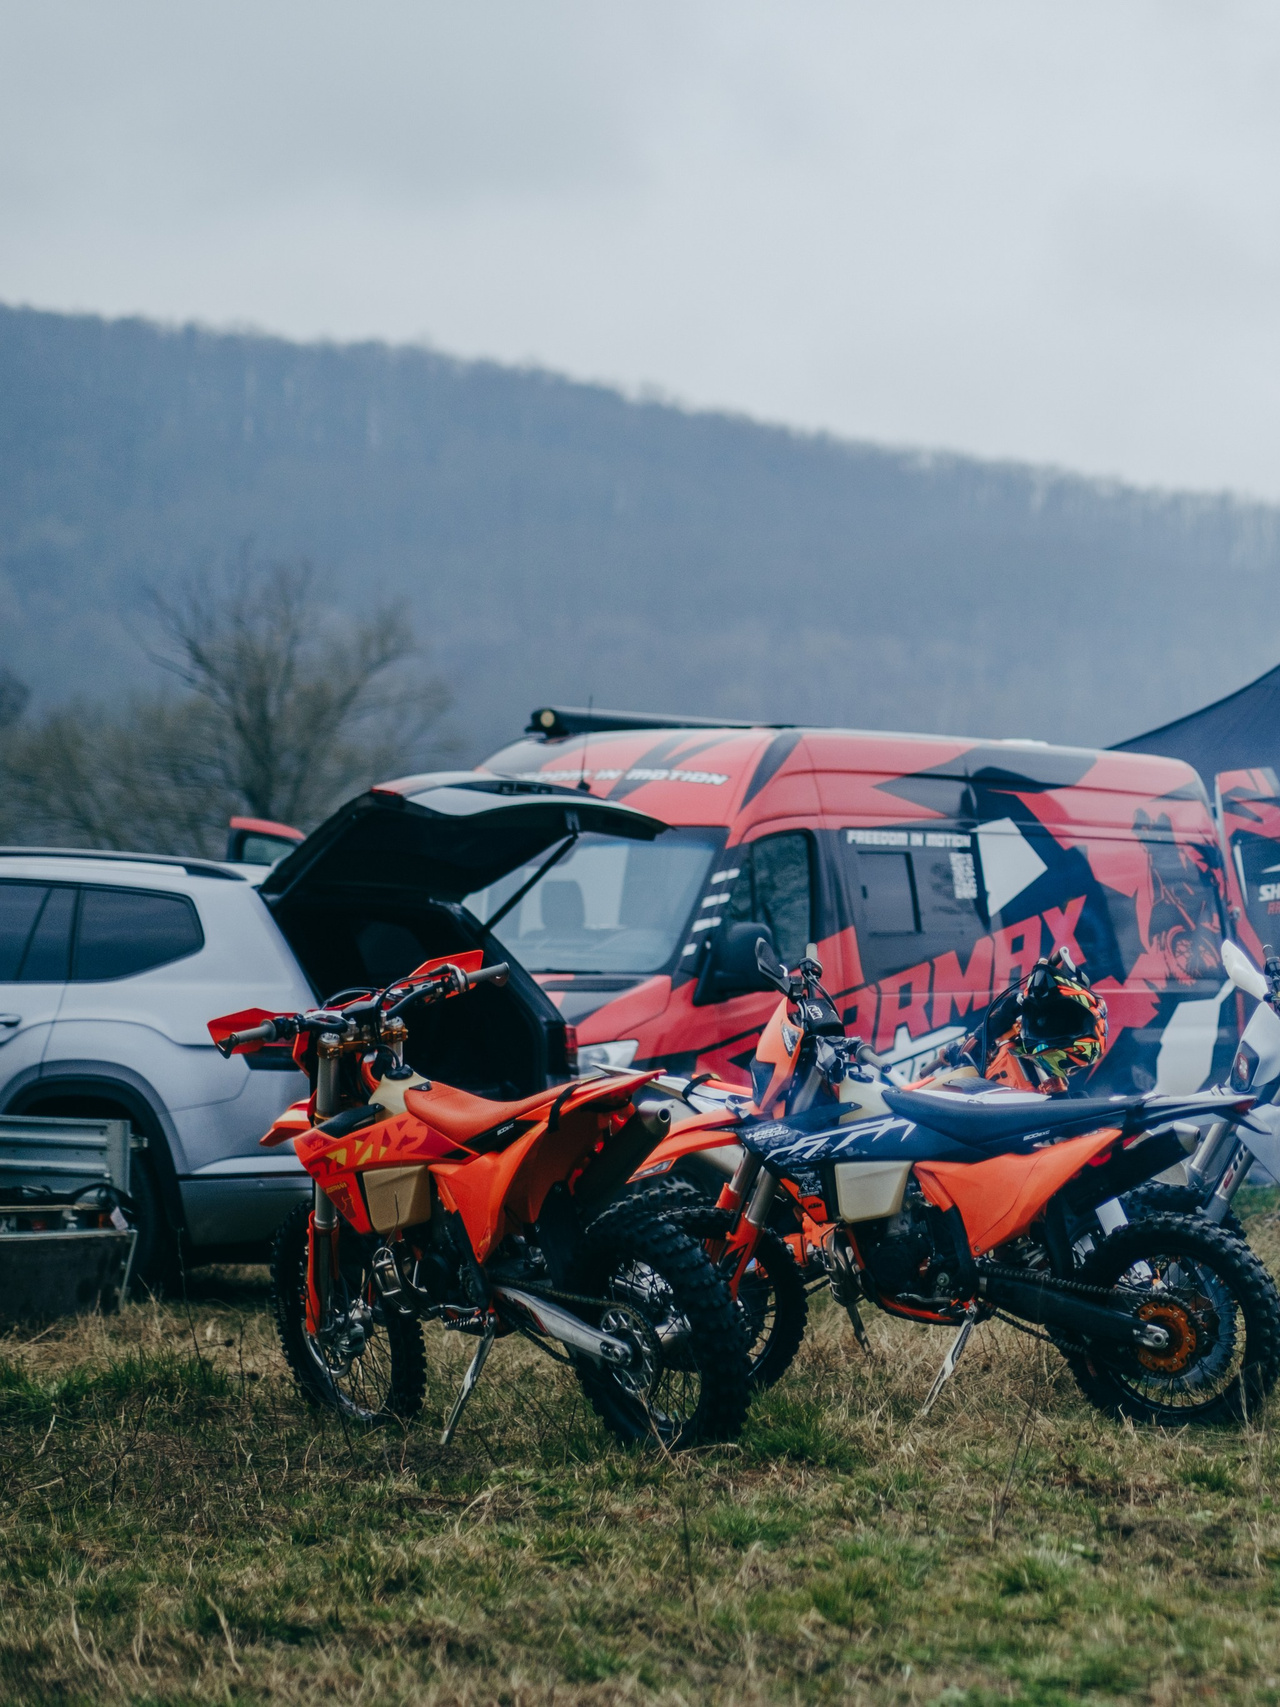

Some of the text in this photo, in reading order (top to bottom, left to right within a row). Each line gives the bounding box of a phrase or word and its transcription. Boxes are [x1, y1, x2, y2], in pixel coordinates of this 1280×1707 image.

[625, 768, 730, 786] MOTION
[846, 829, 972, 848] FREEDOM IN MOTION
[830, 894, 1087, 1058] ARMAX
